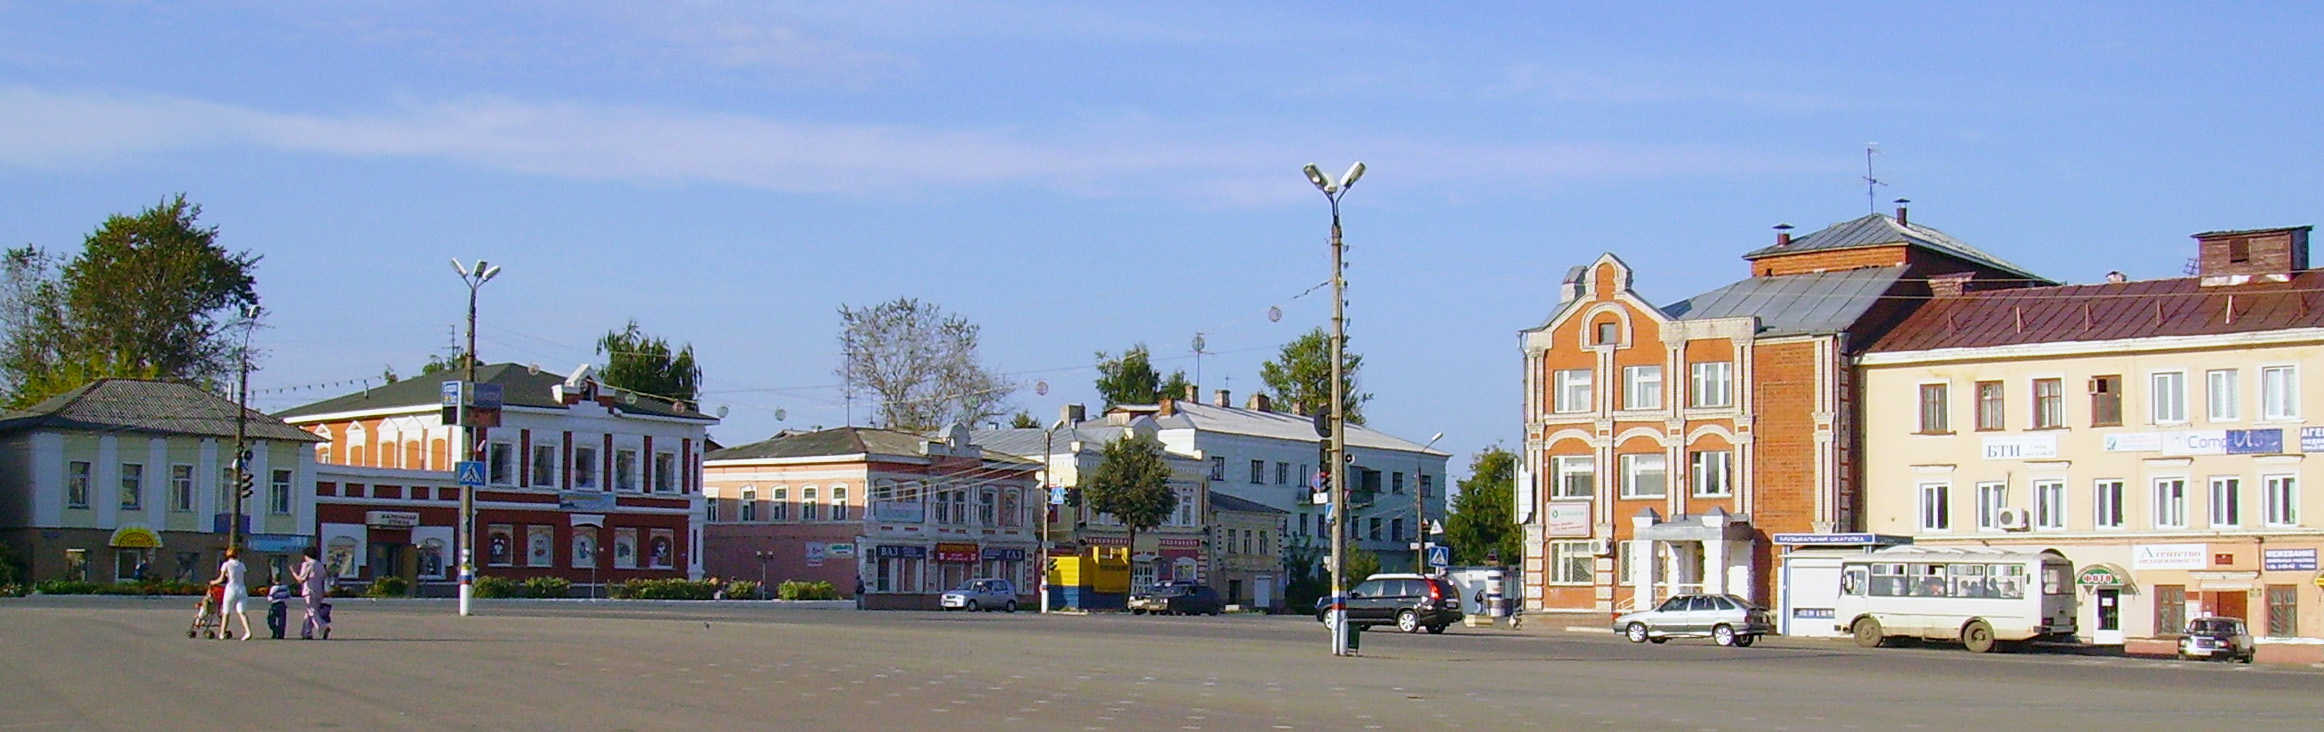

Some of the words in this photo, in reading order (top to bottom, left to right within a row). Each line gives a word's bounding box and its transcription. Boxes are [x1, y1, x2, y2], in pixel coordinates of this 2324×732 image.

[2301, 428, 2324, 437] АГЕ
[1987, 445, 2020, 458] БТИ
[881, 547, 899, 556] ВАЗ
[1006, 551, 1022, 559] ГАЗ
